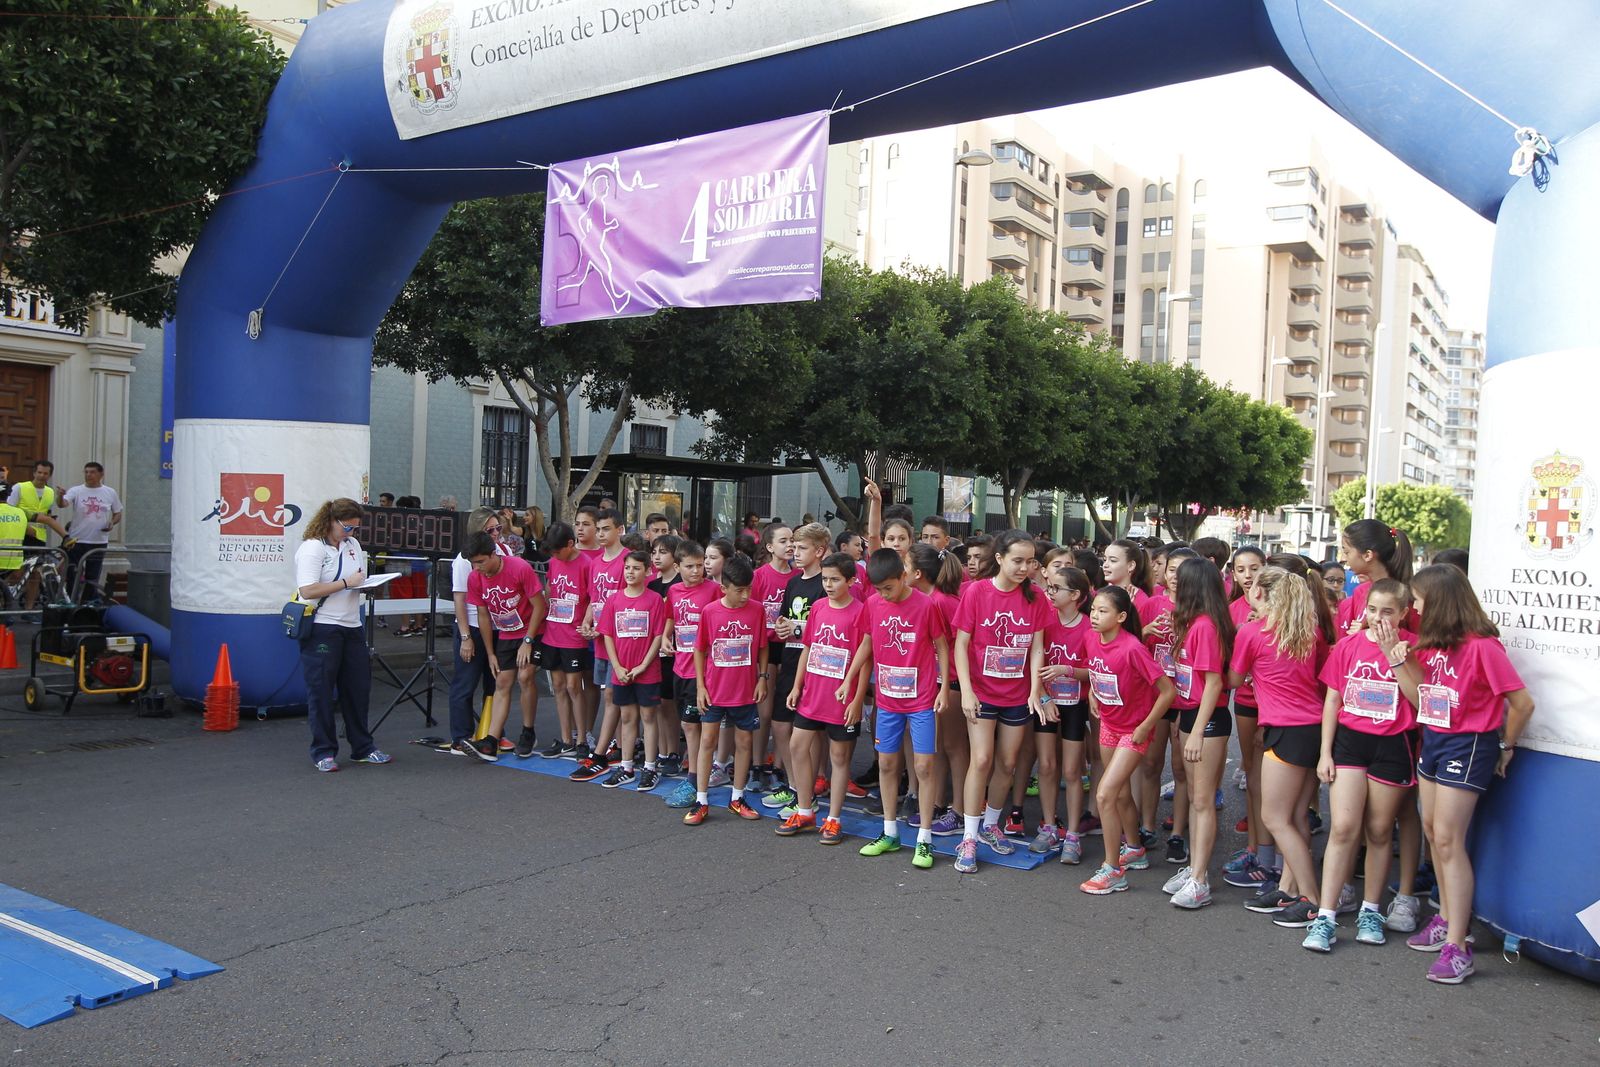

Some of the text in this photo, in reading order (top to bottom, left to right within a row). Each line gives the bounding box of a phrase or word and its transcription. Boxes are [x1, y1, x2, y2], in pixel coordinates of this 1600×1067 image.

[470, 24, 565, 67] Concejalía
[571, 16, 594, 41] de
[715, 163, 817, 207] CARRERA
[680, 181, 716, 264] 4
[713, 193, 816, 233] SOLIDARIA
[218, 543, 285, 552] DEPORTES
[218, 553, 233, 562] DE
[1511, 568, 1593, 588] EXCMO.
[1490, 610, 1512, 627] DE
[1511, 636, 1523, 649] de
[1525, 638, 1580, 655] Deportes
